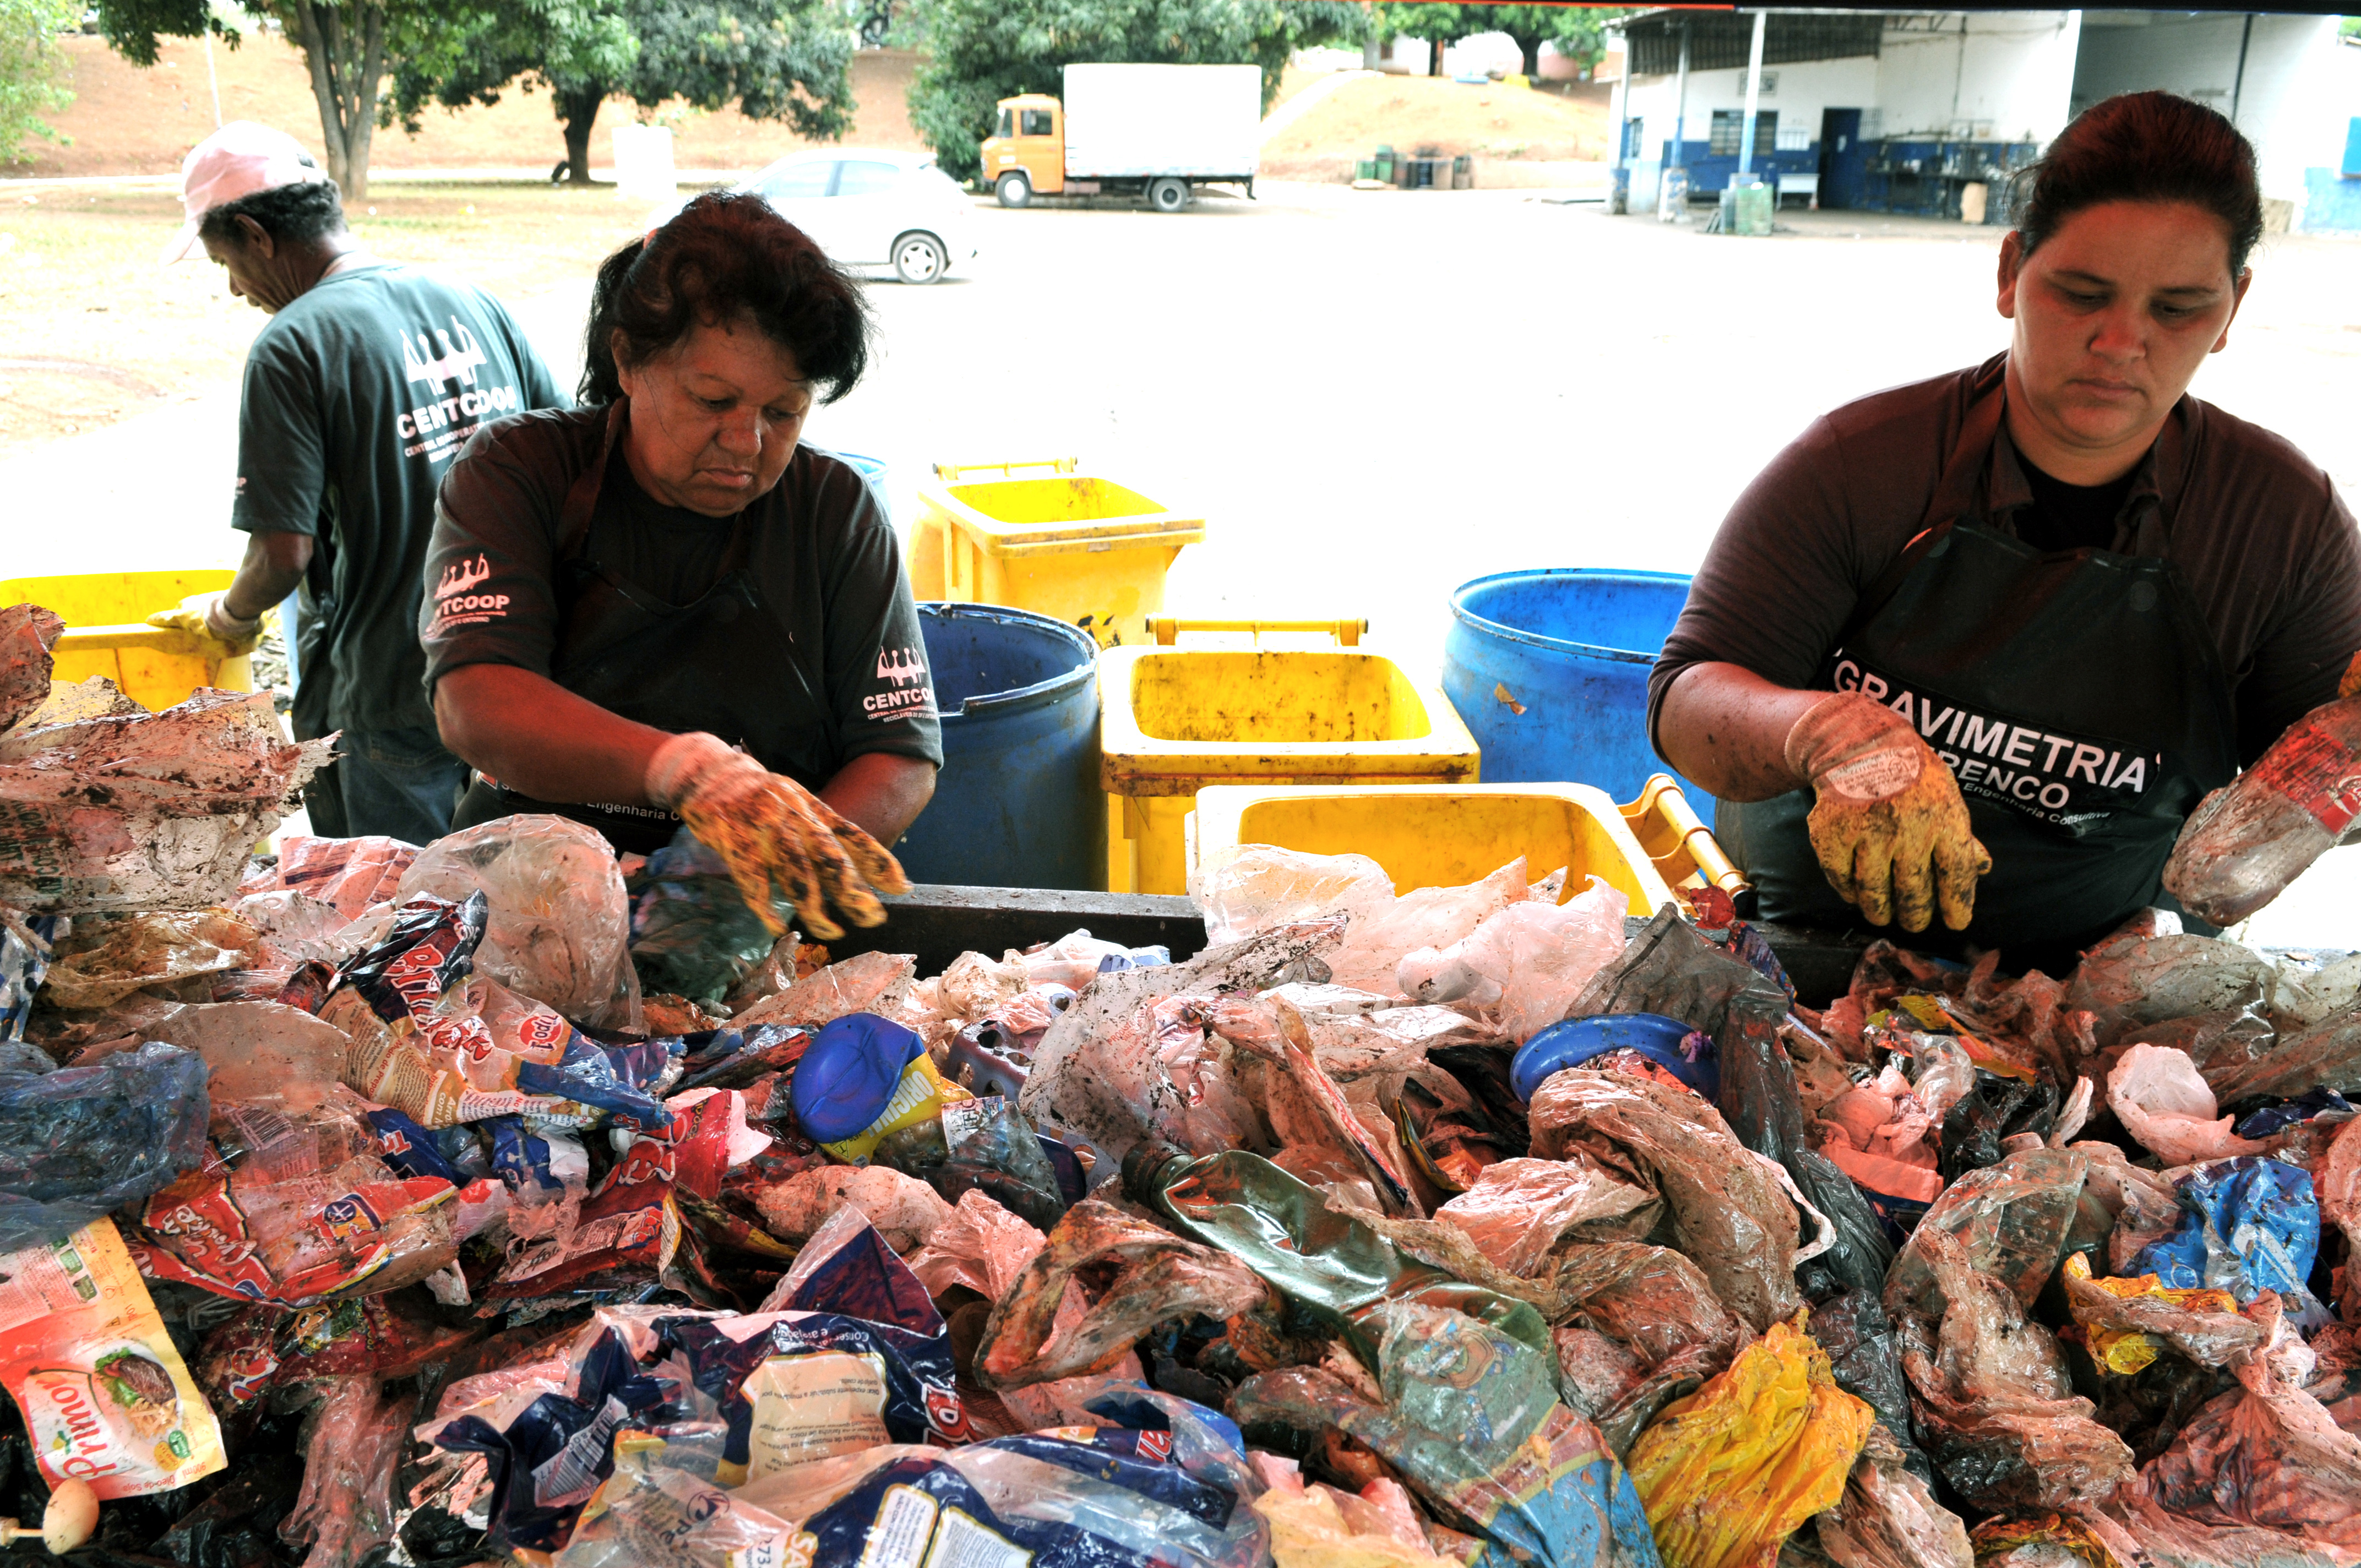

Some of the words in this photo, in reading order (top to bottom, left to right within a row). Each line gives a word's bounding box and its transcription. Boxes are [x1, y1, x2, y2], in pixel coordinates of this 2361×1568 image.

[863, 687, 934, 711] CENTCO
[1834, 660, 2147, 793] GRAVIMETRIA
[1932, 748, 2070, 809] RENCO
[535, 1015, 558, 1037] Tipo
[383, 1041, 402, 1059] Modo
[532, 1042, 554, 1052] 1
[379, 1060, 389, 1070] de
[437, 1092, 446, 1115] com
[837, 1386, 866, 1395] expemente
[35, 1377, 116, 1476] Primor
[122, 1483, 143, 1492] Soja
